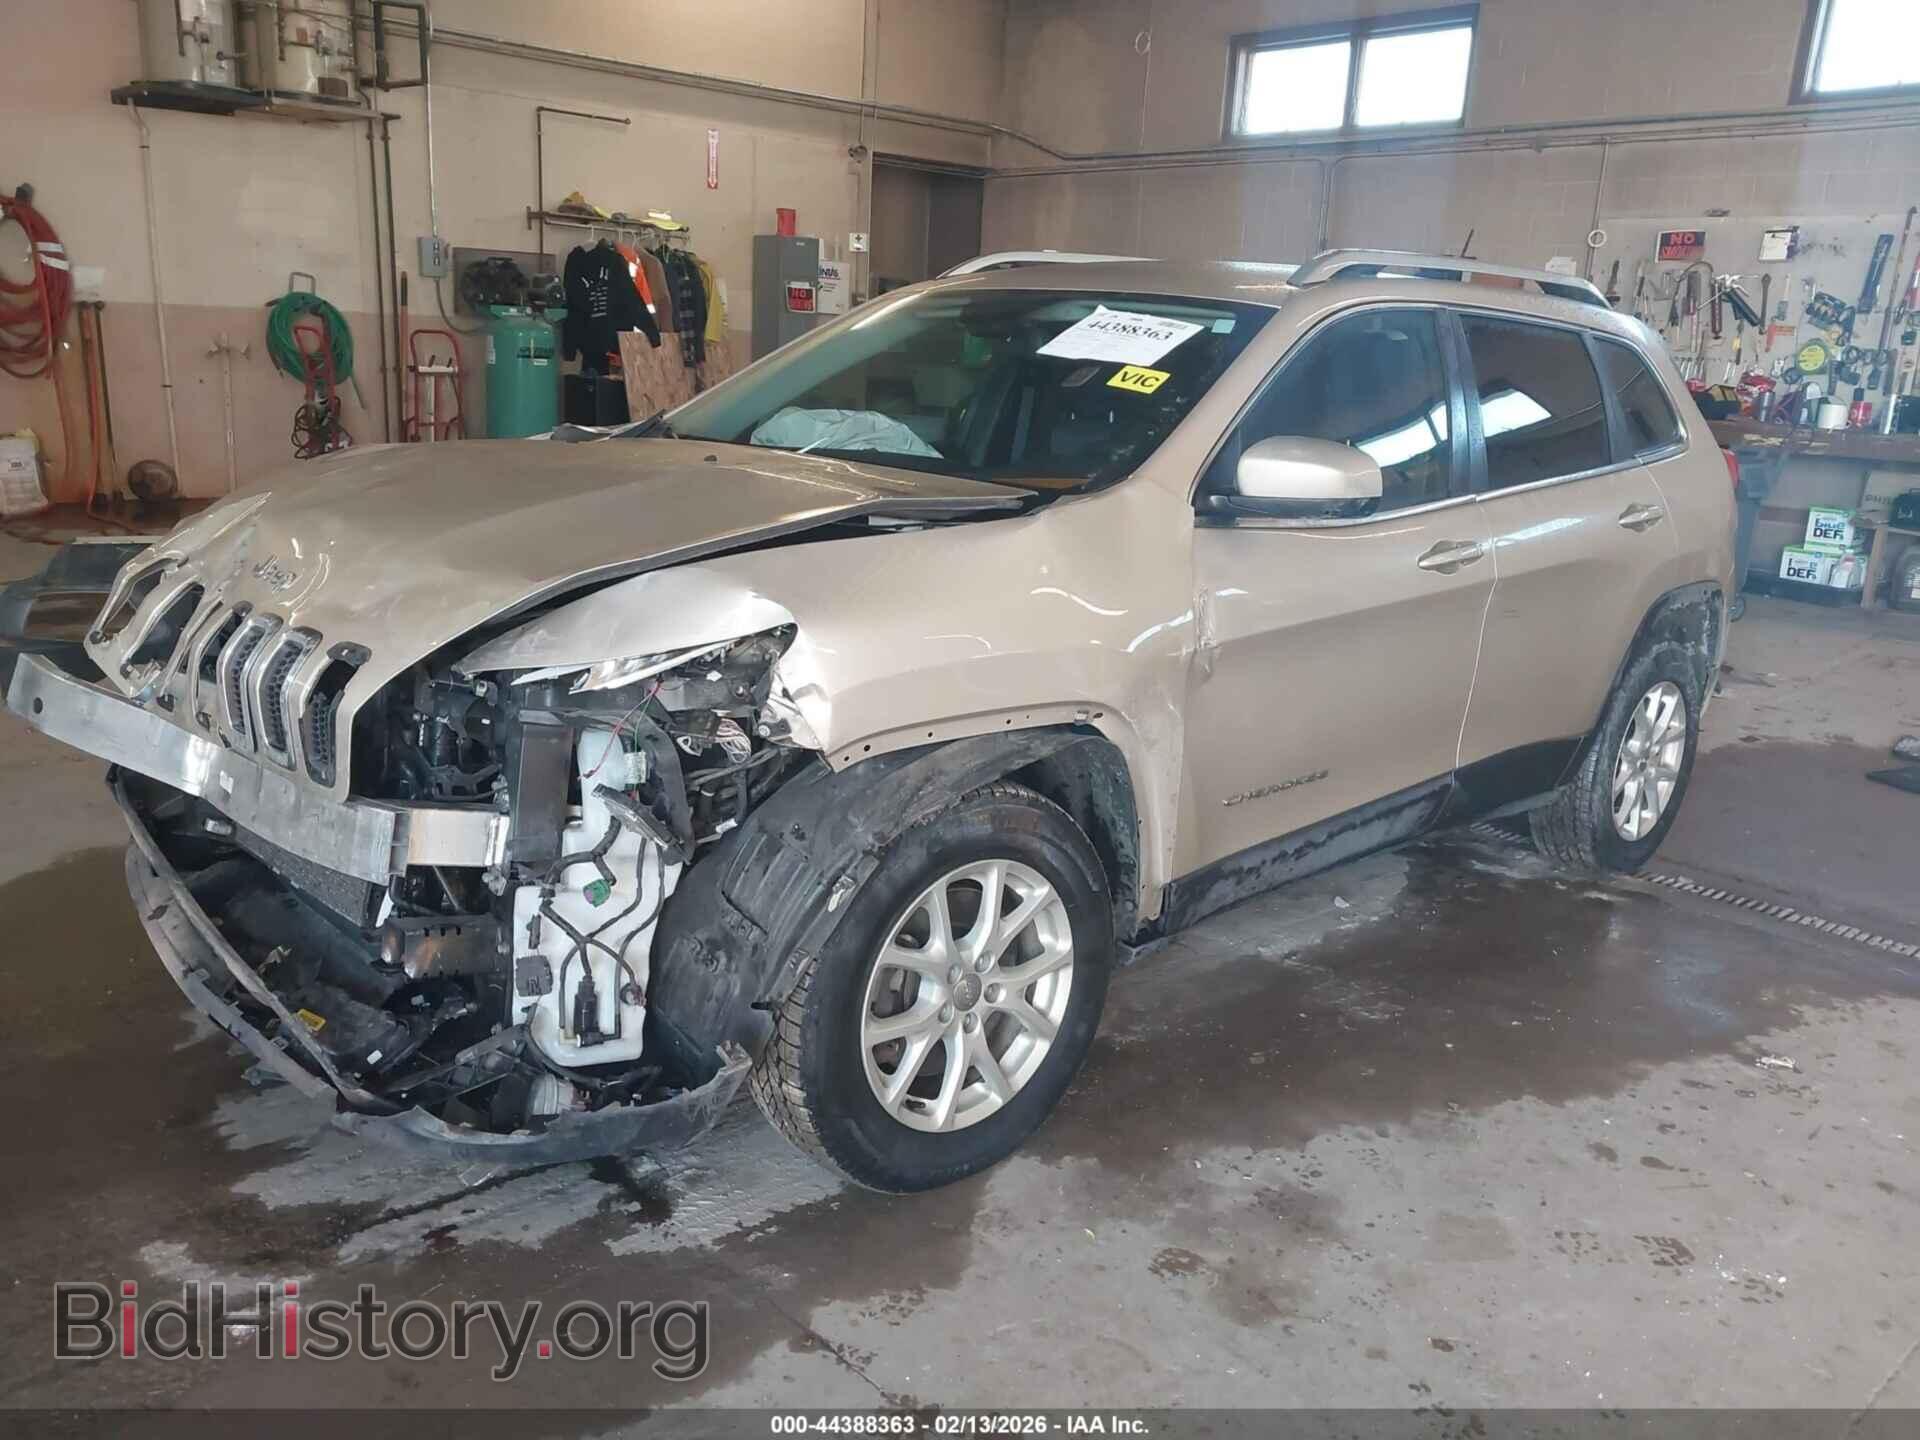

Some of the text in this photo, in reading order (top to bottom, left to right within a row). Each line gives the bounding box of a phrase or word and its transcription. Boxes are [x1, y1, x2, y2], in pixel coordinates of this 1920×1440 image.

[1670, 233, 1695, 245] NO
[1088, 322, 1173, 340] 44388363
[1119, 370, 1160, 388] VIC
